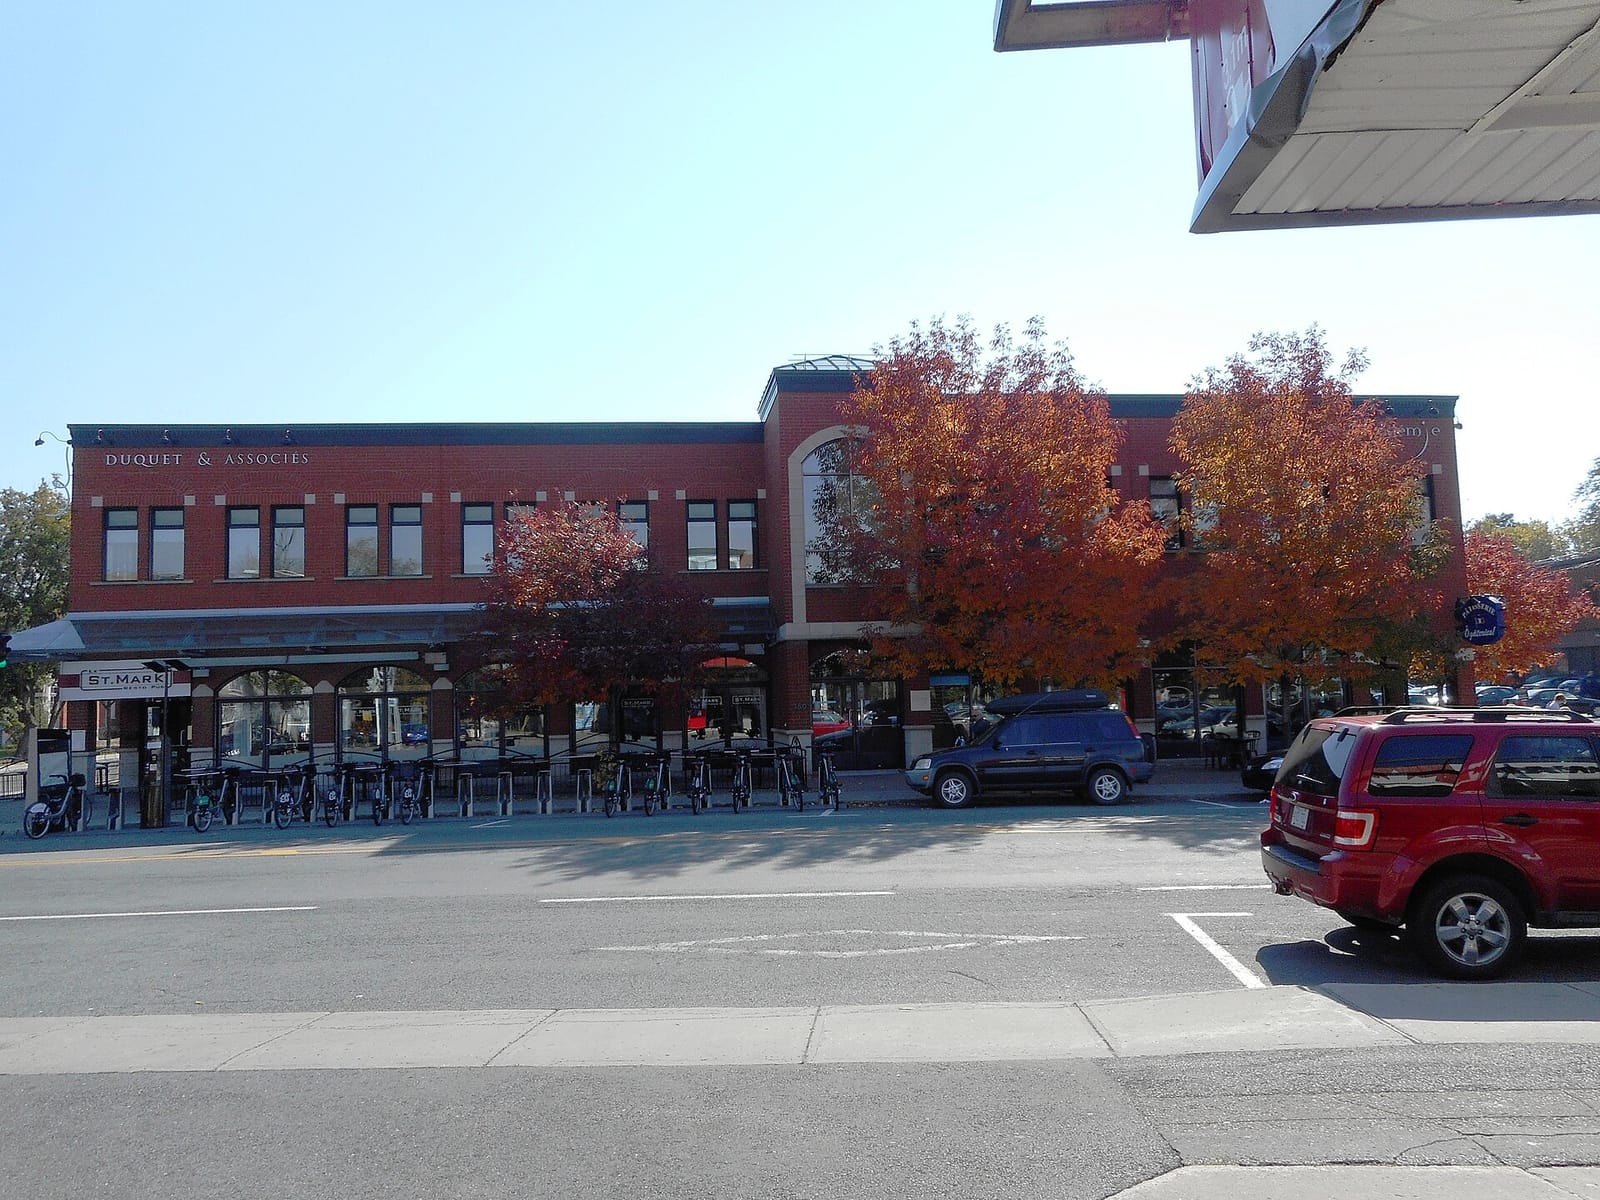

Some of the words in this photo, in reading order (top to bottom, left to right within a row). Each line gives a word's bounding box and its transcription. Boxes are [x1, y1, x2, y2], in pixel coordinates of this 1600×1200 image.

[105, 454, 182, 467] DUQUET
[198, 452, 212, 466] &
[224, 451, 310, 464] ASSOCIÉS
